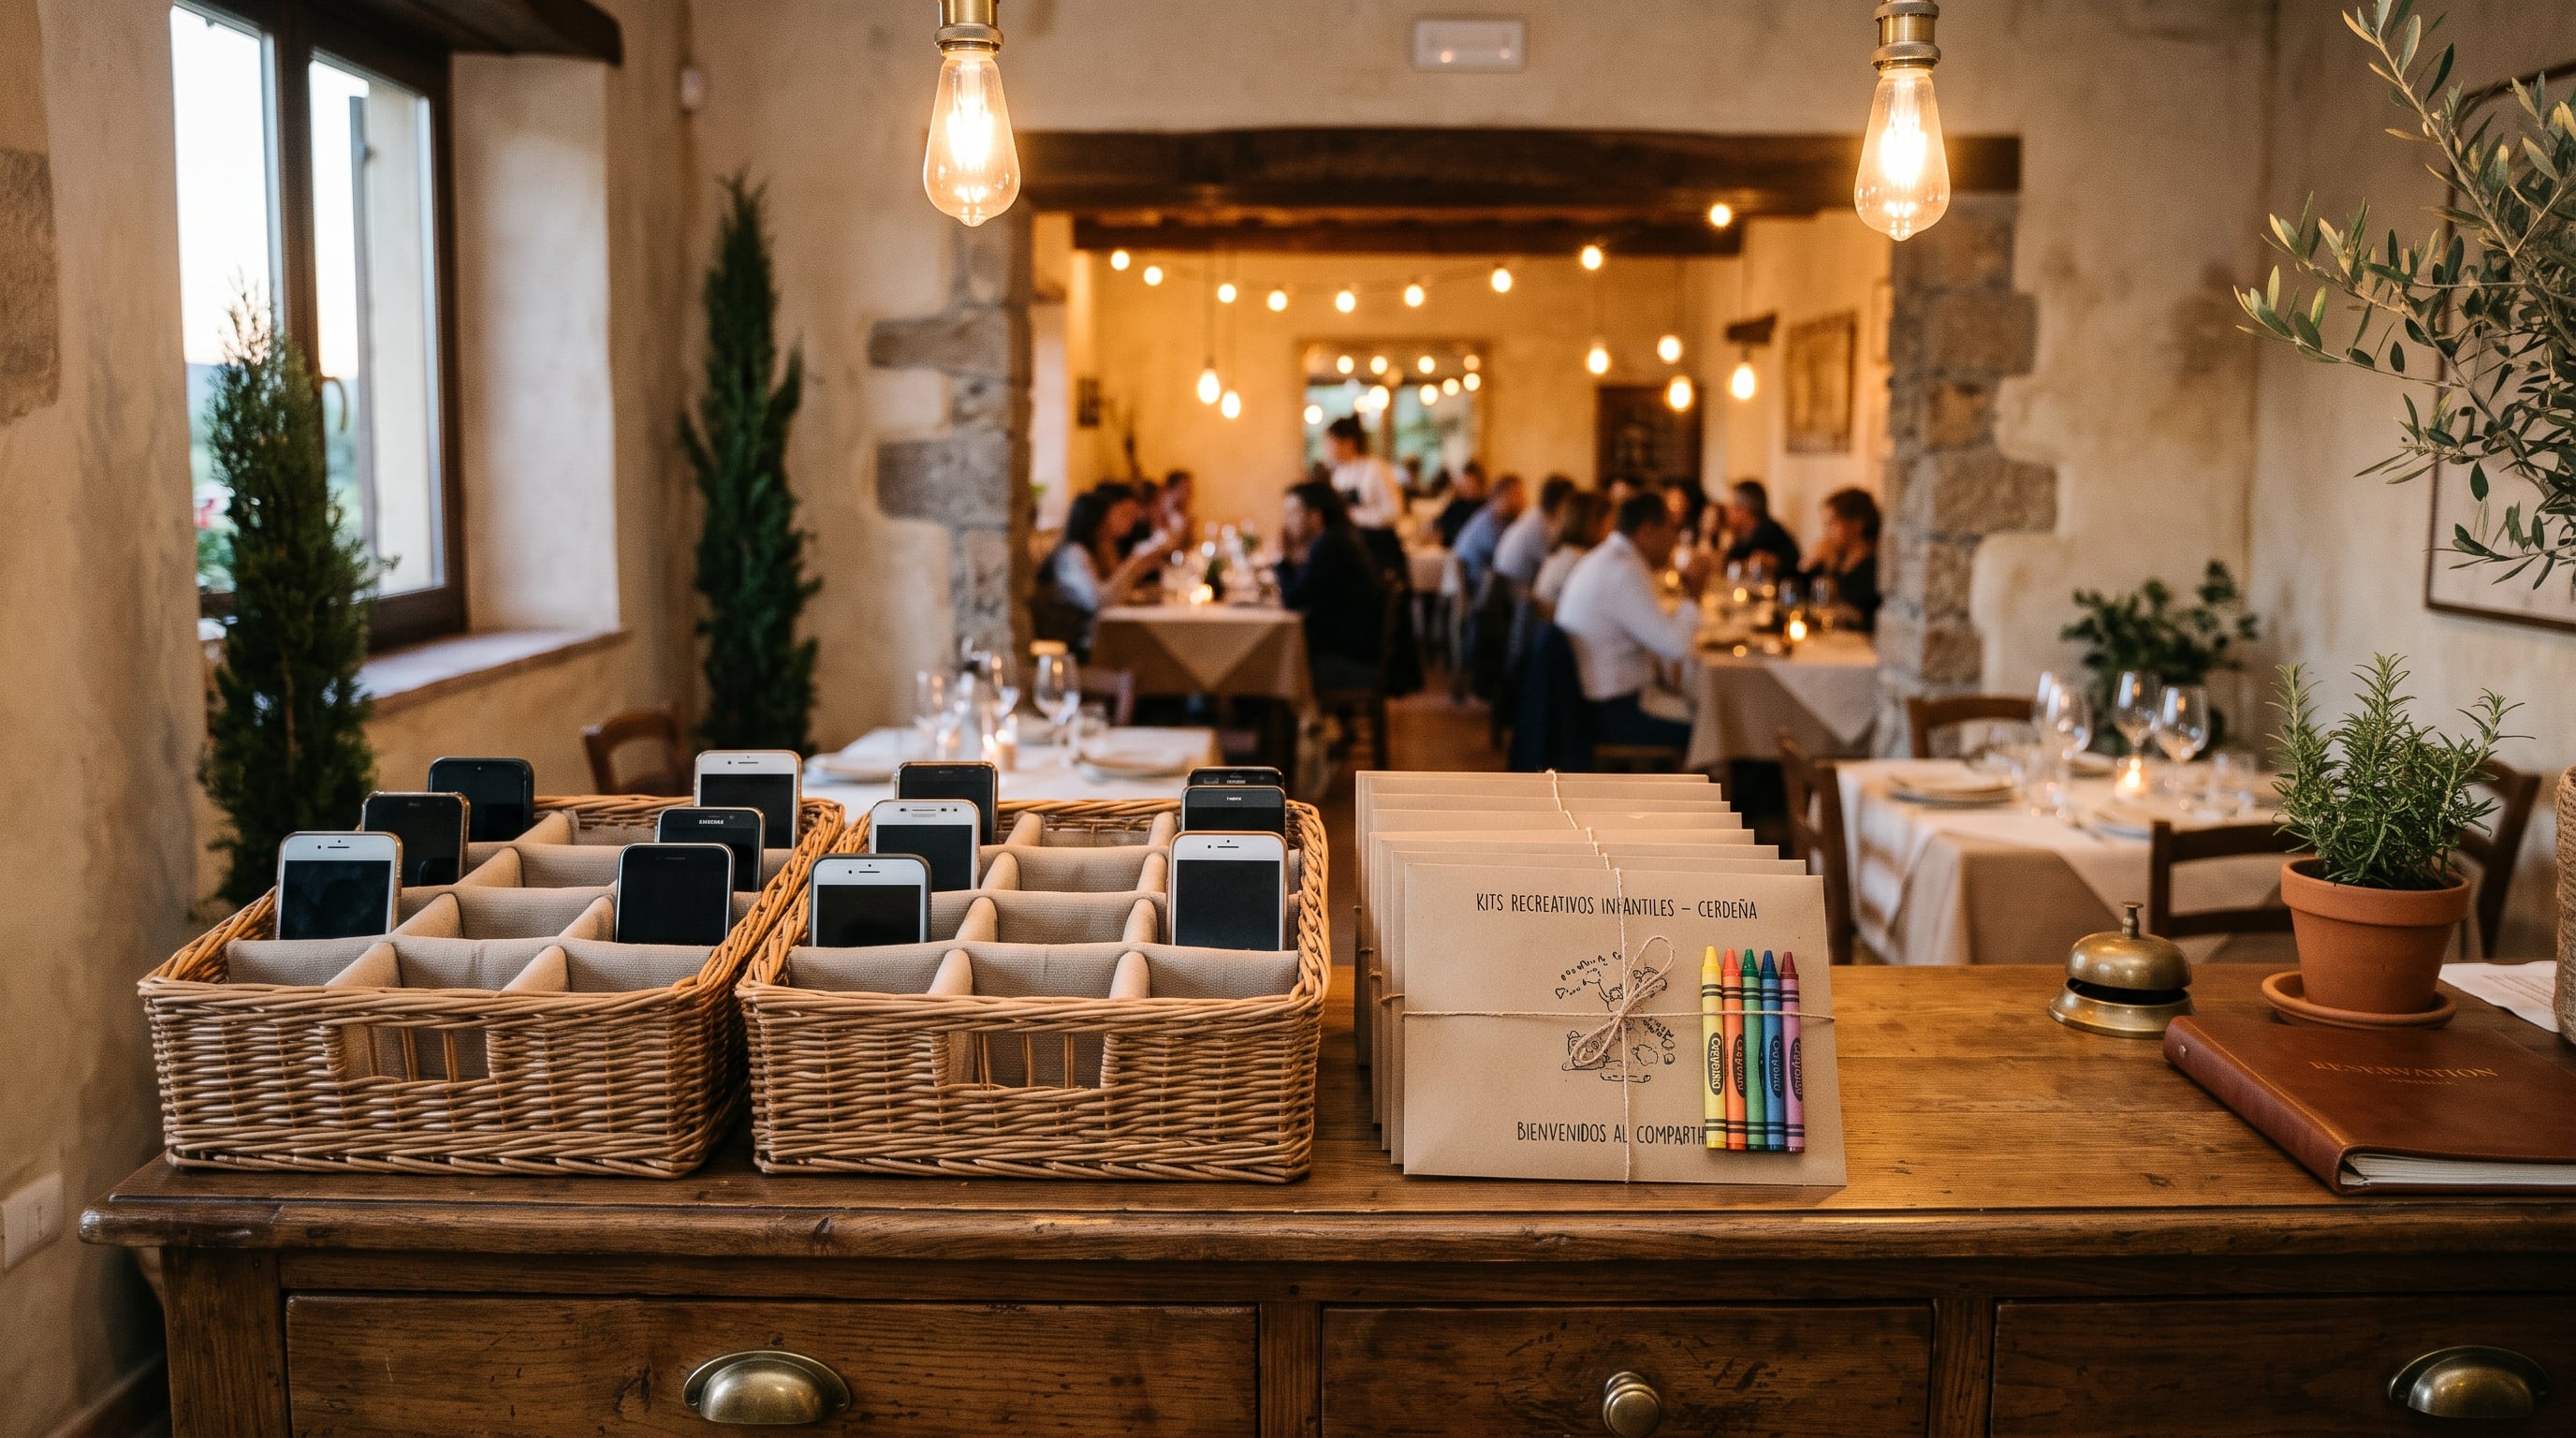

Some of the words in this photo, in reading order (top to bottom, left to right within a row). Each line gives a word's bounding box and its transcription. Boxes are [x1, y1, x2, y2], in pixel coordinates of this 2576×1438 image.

[1476, 893, 1503, 912] KITS
[1511, 894, 1594, 915] RECREATIVOS
[1602, 897, 1675, 917] INFANTILES
[1698, 899, 1758, 919] CERDEÑA
[2308, 1061, 2499, 1077] RESERVATION
[1517, 1122, 1606, 1142] BIENVENIDOS
[1613, 1124, 1628, 1142] AL
